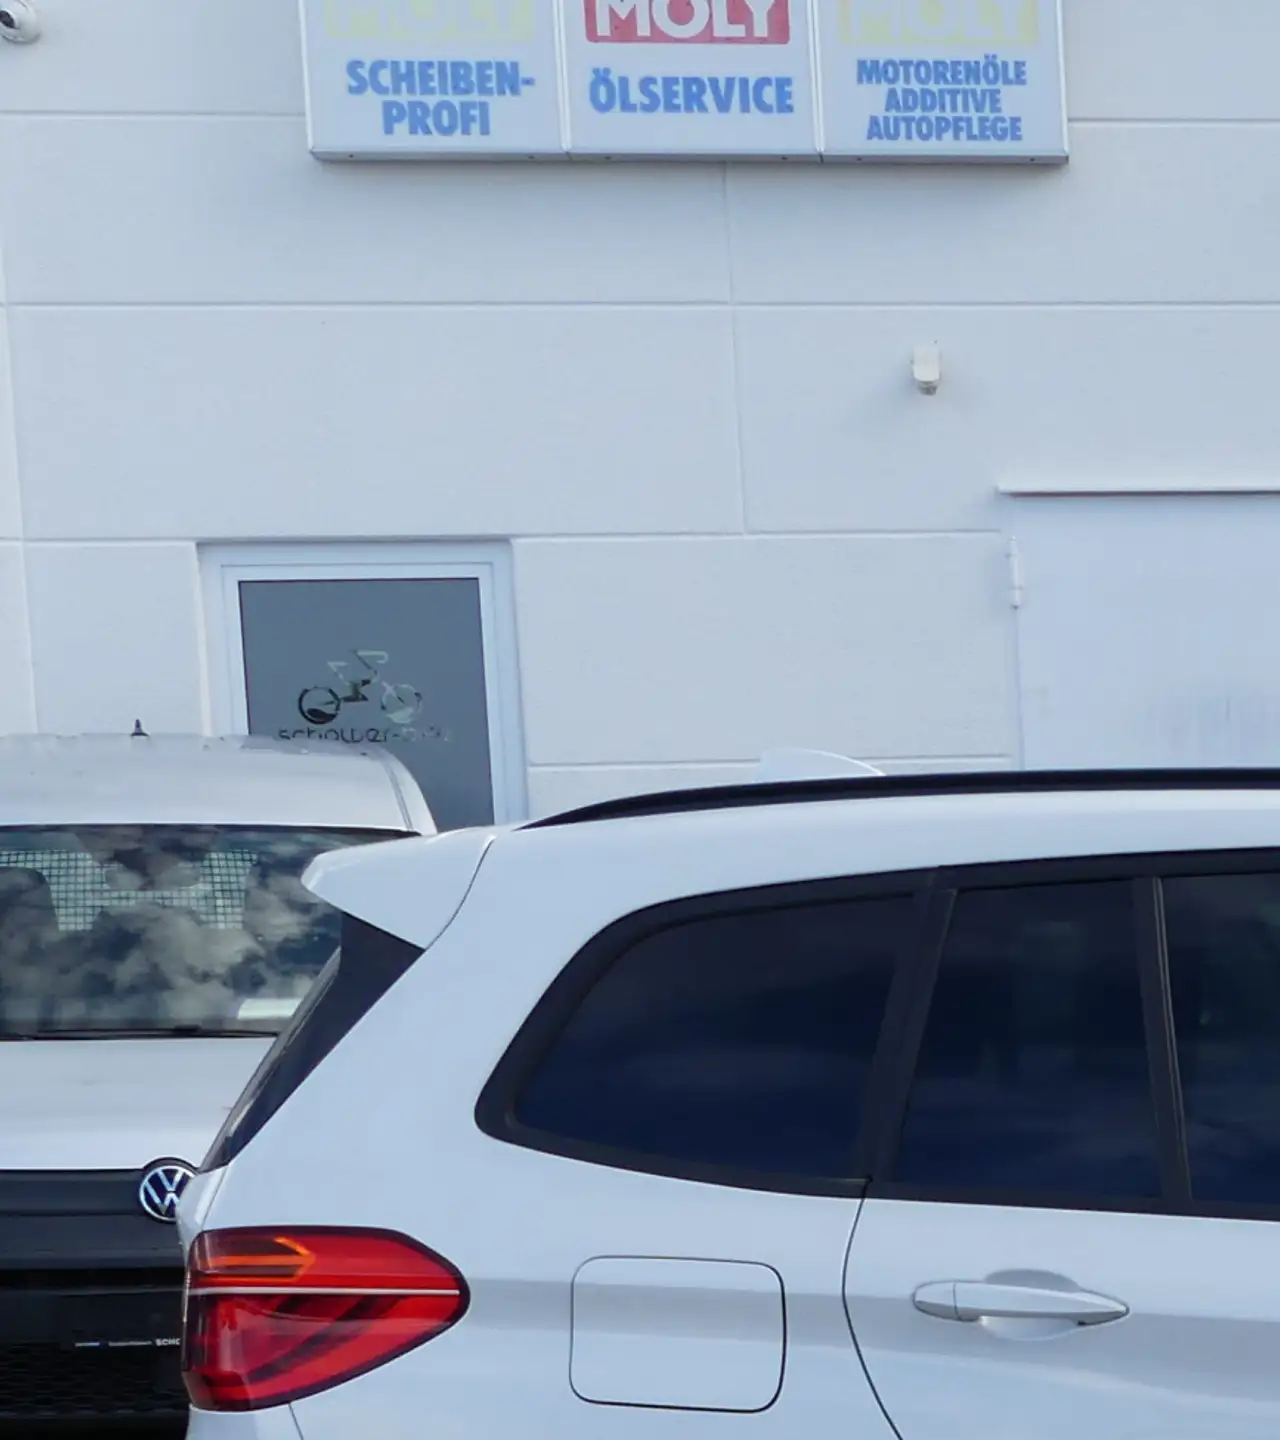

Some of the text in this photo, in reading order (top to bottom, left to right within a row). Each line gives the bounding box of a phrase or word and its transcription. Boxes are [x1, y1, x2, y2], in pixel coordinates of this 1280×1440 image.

[596, 0, 775, 38] MOLY
[346, 59, 535, 95] SCHEIBEN-
[856, 54, 1027, 85] MOTORENÖLE
[589, 67, 794, 114] ÖLSERVICE
[884, 88, 1003, 113] ADDITIVE
[382, 100, 491, 136] PROFI
[866, 115, 1022, 141] AUTOPFLEGE
